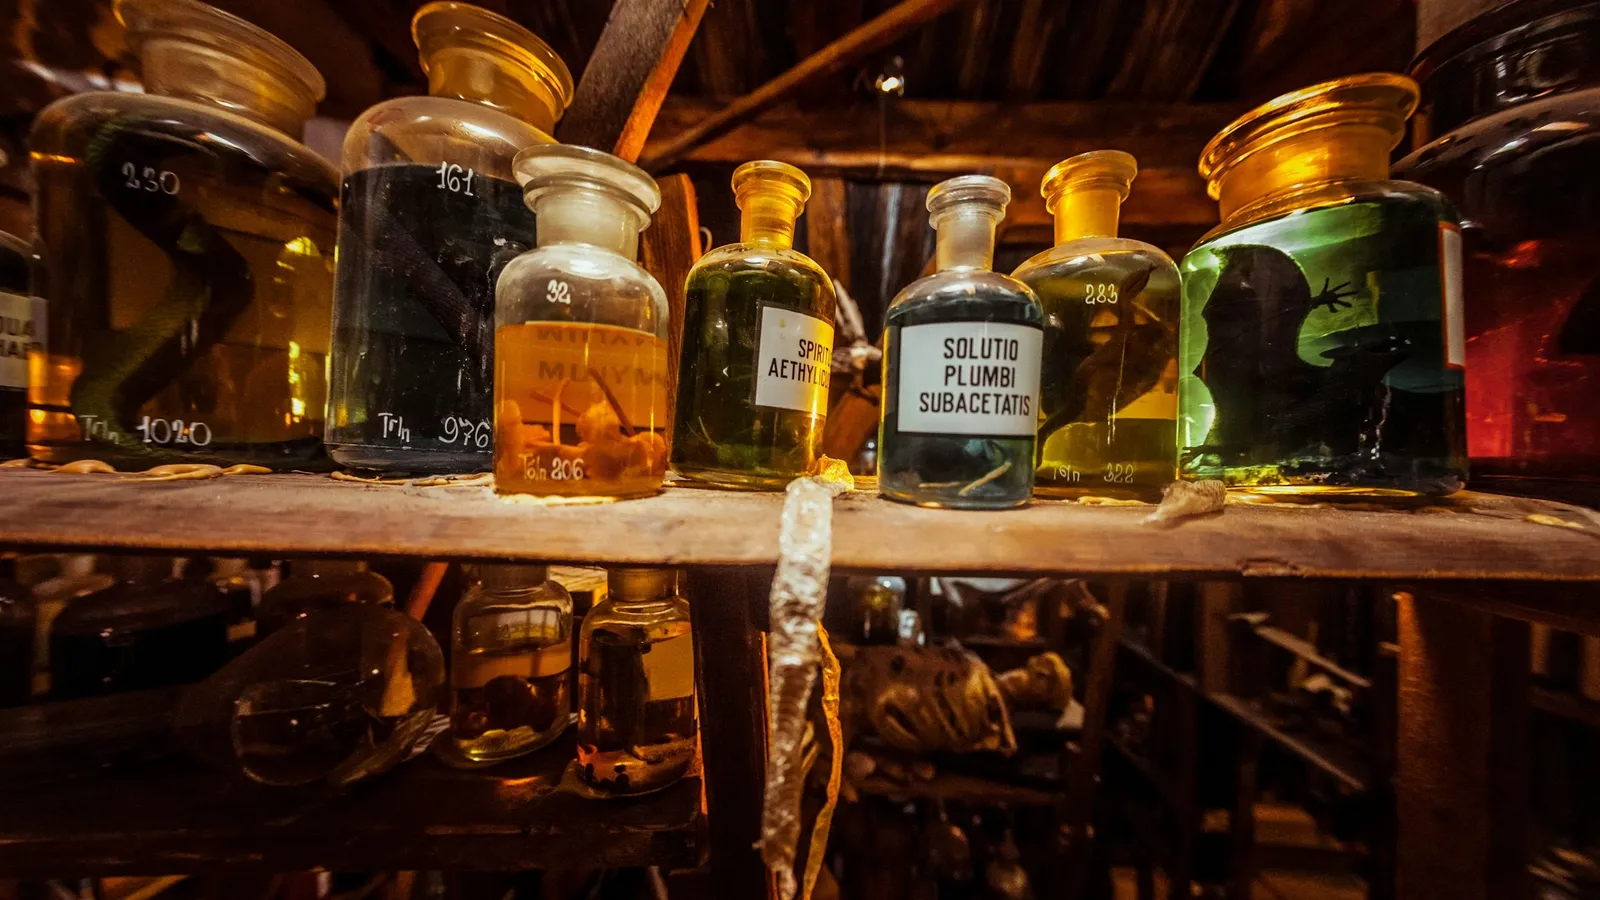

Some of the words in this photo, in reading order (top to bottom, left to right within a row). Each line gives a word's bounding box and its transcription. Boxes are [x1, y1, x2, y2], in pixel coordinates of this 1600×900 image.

[121, 161, 181, 195] 230
[436, 160, 474, 197] 161
[546, 279, 571, 305] 32
[1085, 283, 1119, 305] 283
[943, 337, 1019, 361] SOLUTIO
[944, 364, 1016, 389] PLUMBI
[919, 391, 1031, 416] SUBACETATIS
[136, 415, 213, 446] 1020
[438, 416, 491, 448] 976
[550, 456, 585, 481] 206
